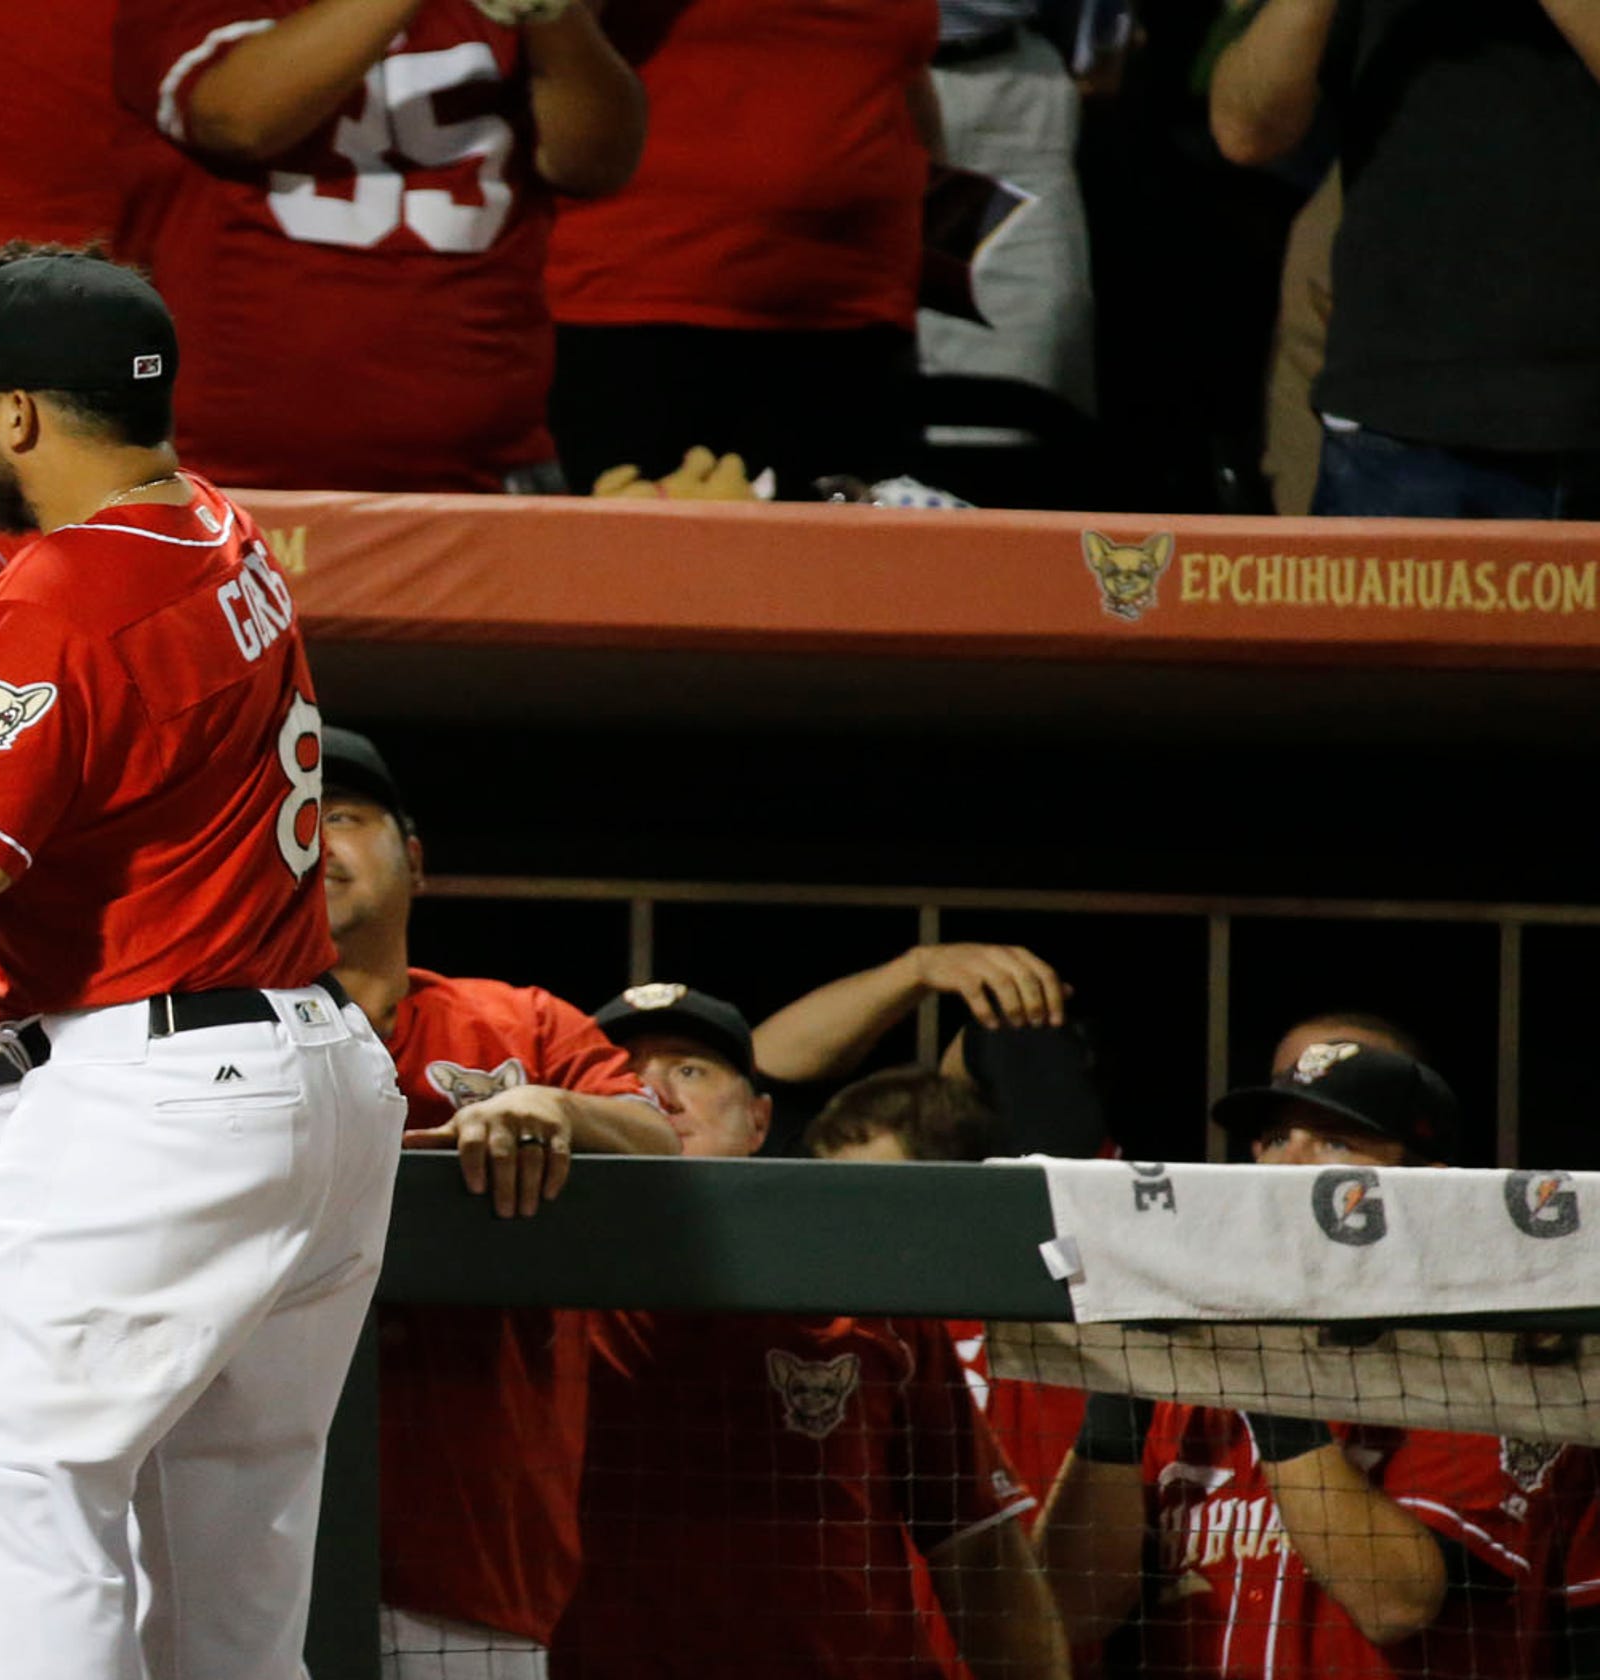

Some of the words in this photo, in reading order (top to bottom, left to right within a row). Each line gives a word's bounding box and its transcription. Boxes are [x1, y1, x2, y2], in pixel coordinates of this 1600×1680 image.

[266, 41, 513, 253] 35
[1179, 552, 1597, 614] EPCHIHUAHUAS.COM
[276, 689, 323, 886] 8
[1311, 1167, 1388, 1246] G
[1503, 1169, 1581, 1239] G
